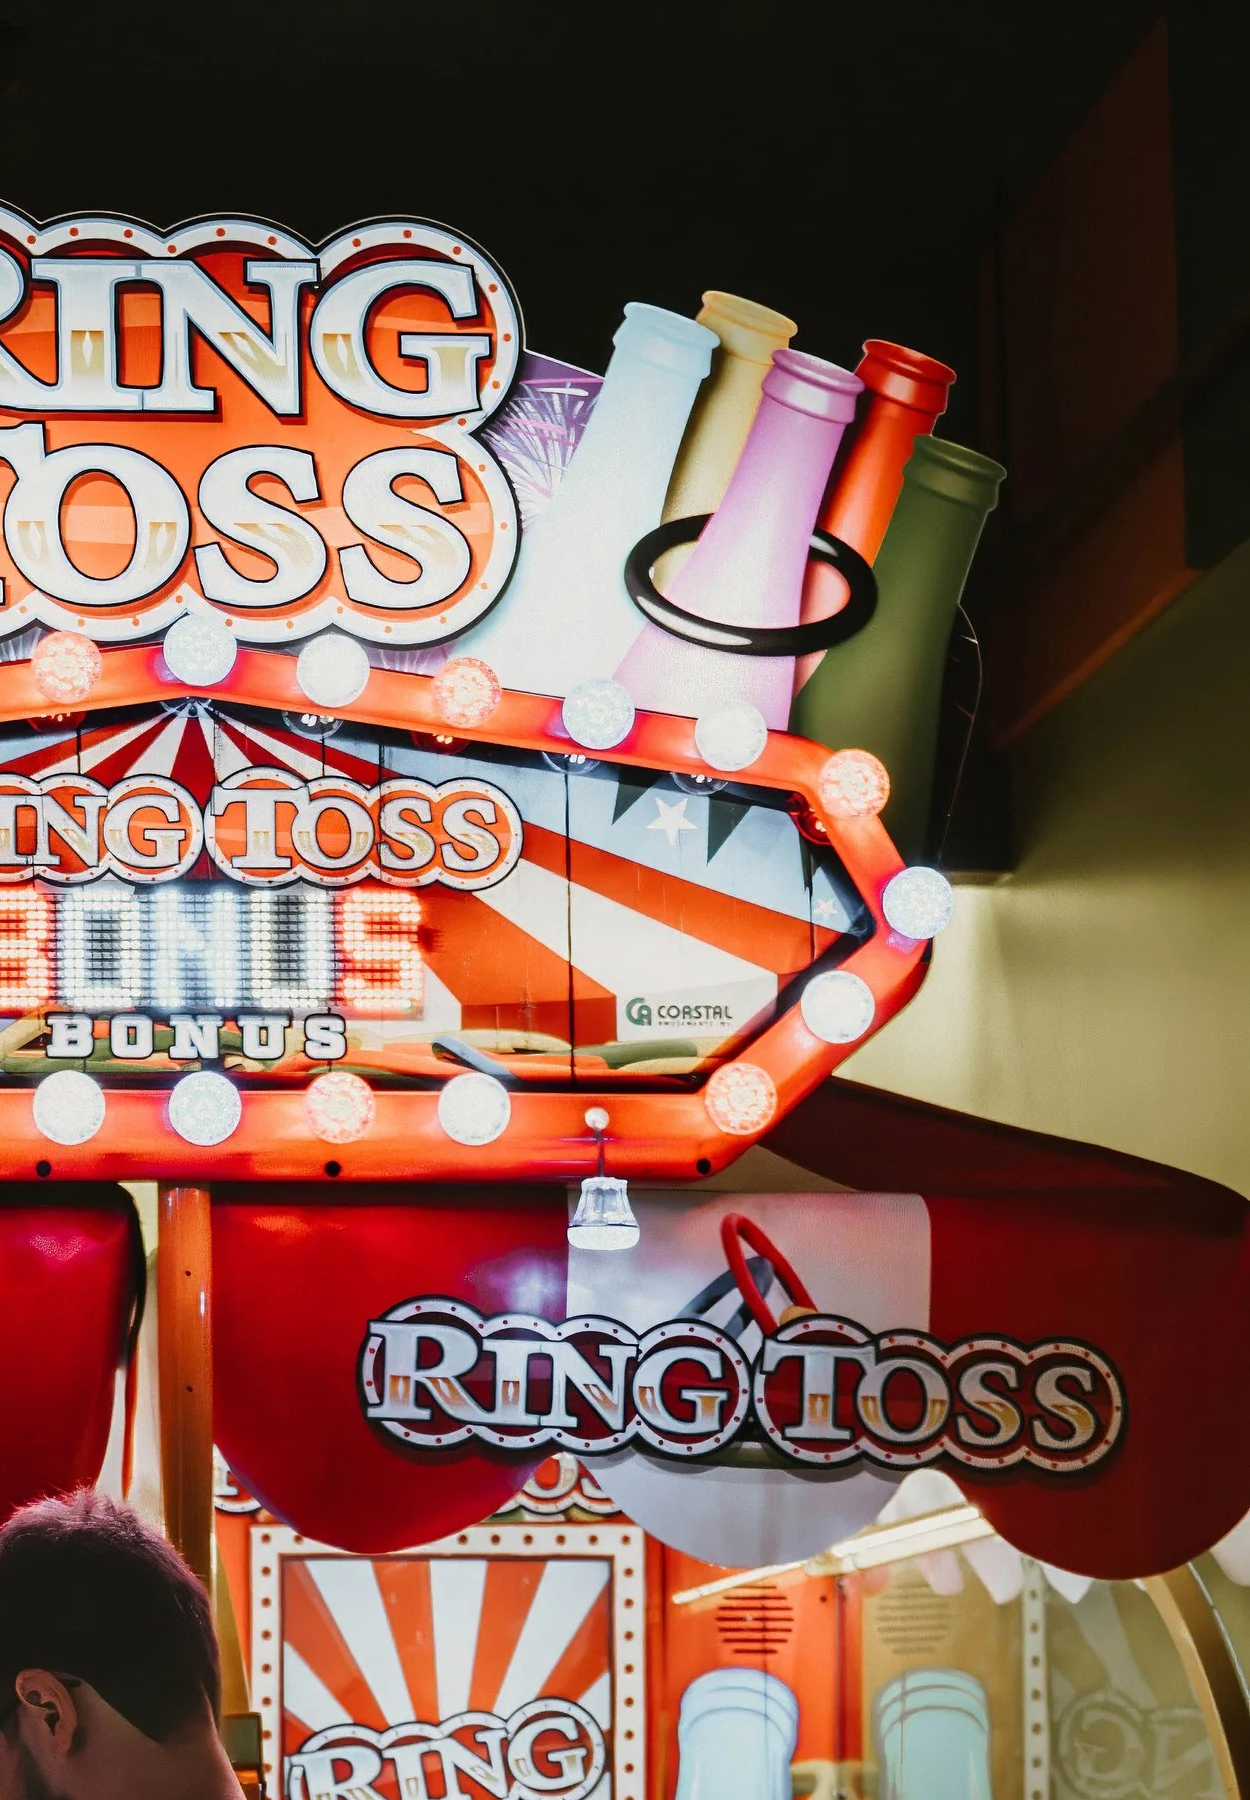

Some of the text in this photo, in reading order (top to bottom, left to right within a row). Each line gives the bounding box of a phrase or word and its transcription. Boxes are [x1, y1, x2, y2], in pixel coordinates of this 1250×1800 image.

[214, 788, 500, 873] TOSS
[47, 1014, 348, 1062] BONUS
[657, 1005, 732, 1020] COASTAL
[367, 1320, 1098, 1453] RING TOSS
